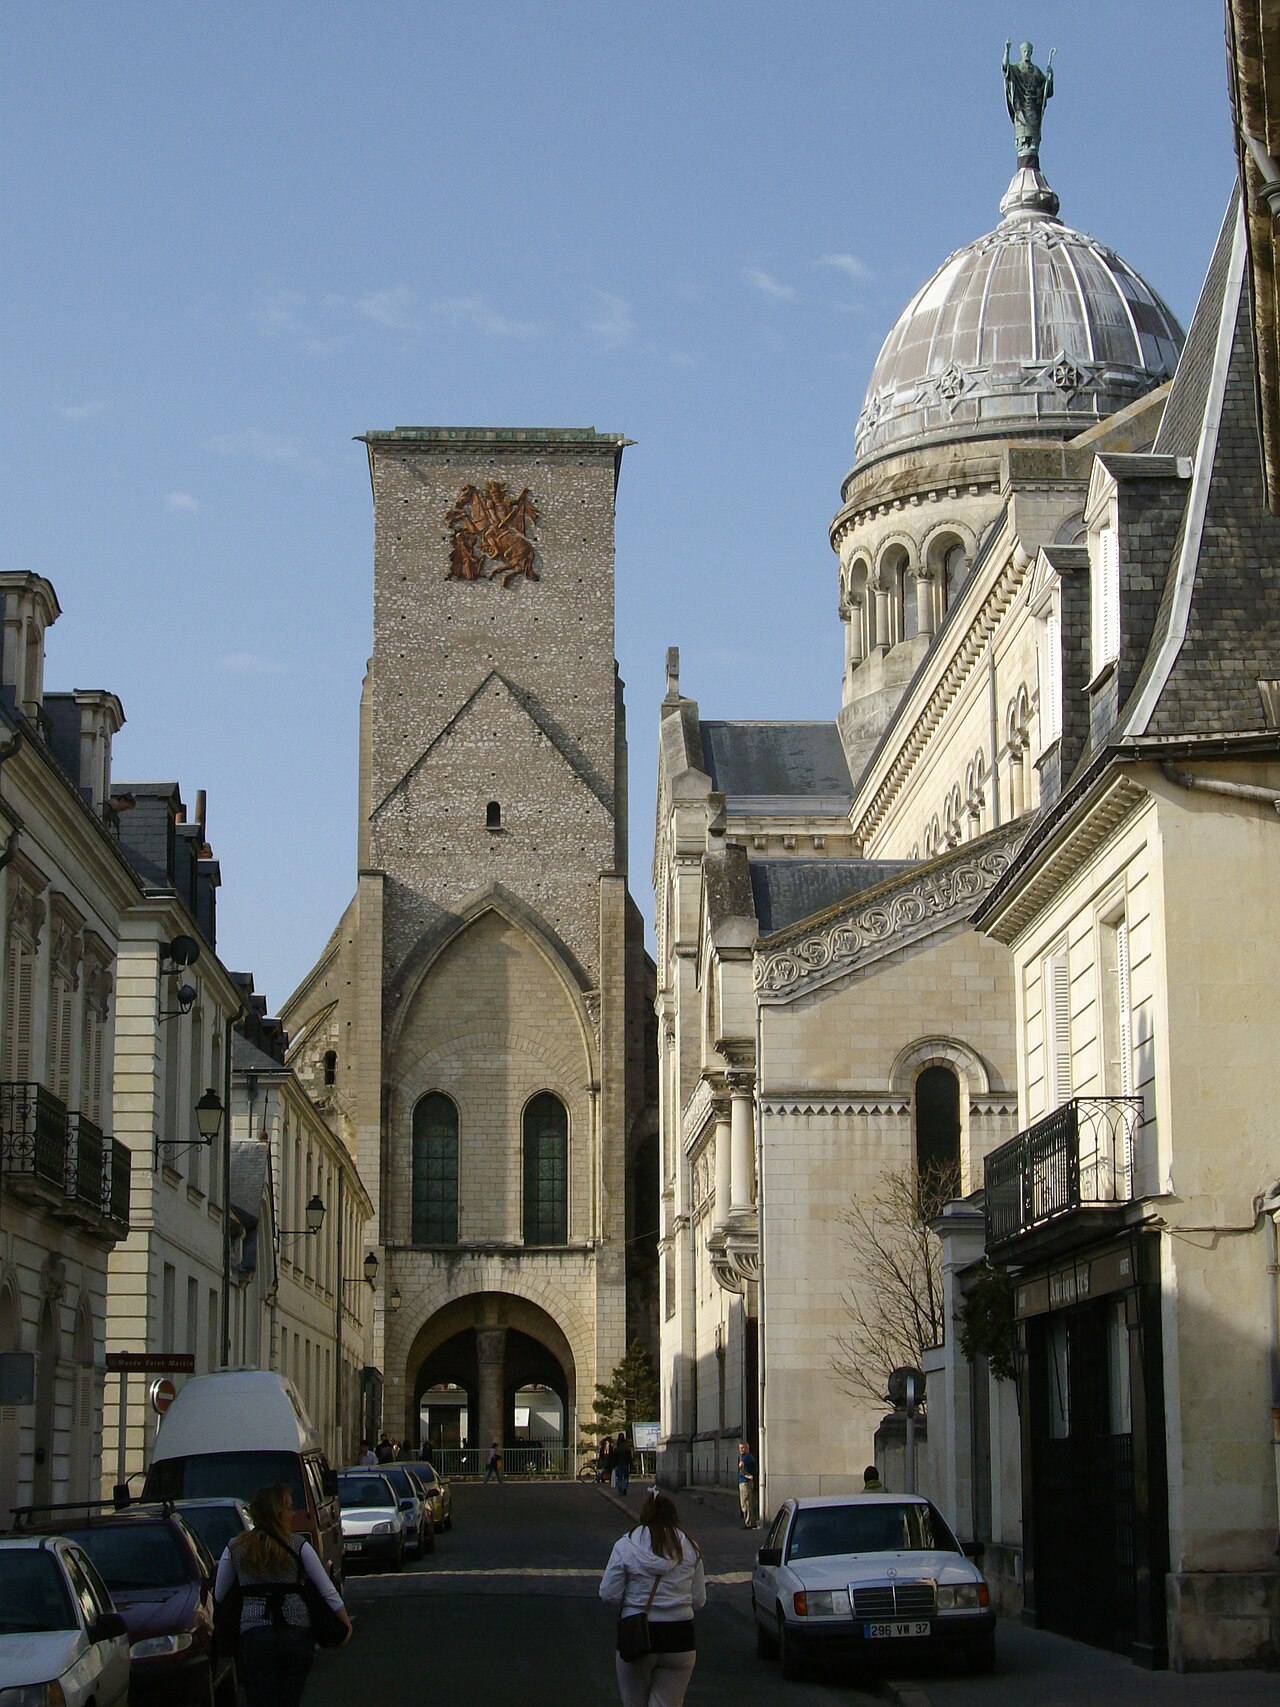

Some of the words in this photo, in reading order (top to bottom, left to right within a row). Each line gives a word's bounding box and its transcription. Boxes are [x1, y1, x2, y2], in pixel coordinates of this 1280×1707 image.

[145, 1359, 164, 1367] Saint
[168, 1359, 194, 1367] Martin
[871, 1625, 892, 1636] 296
[915, 1623, 928, 1634] 37
